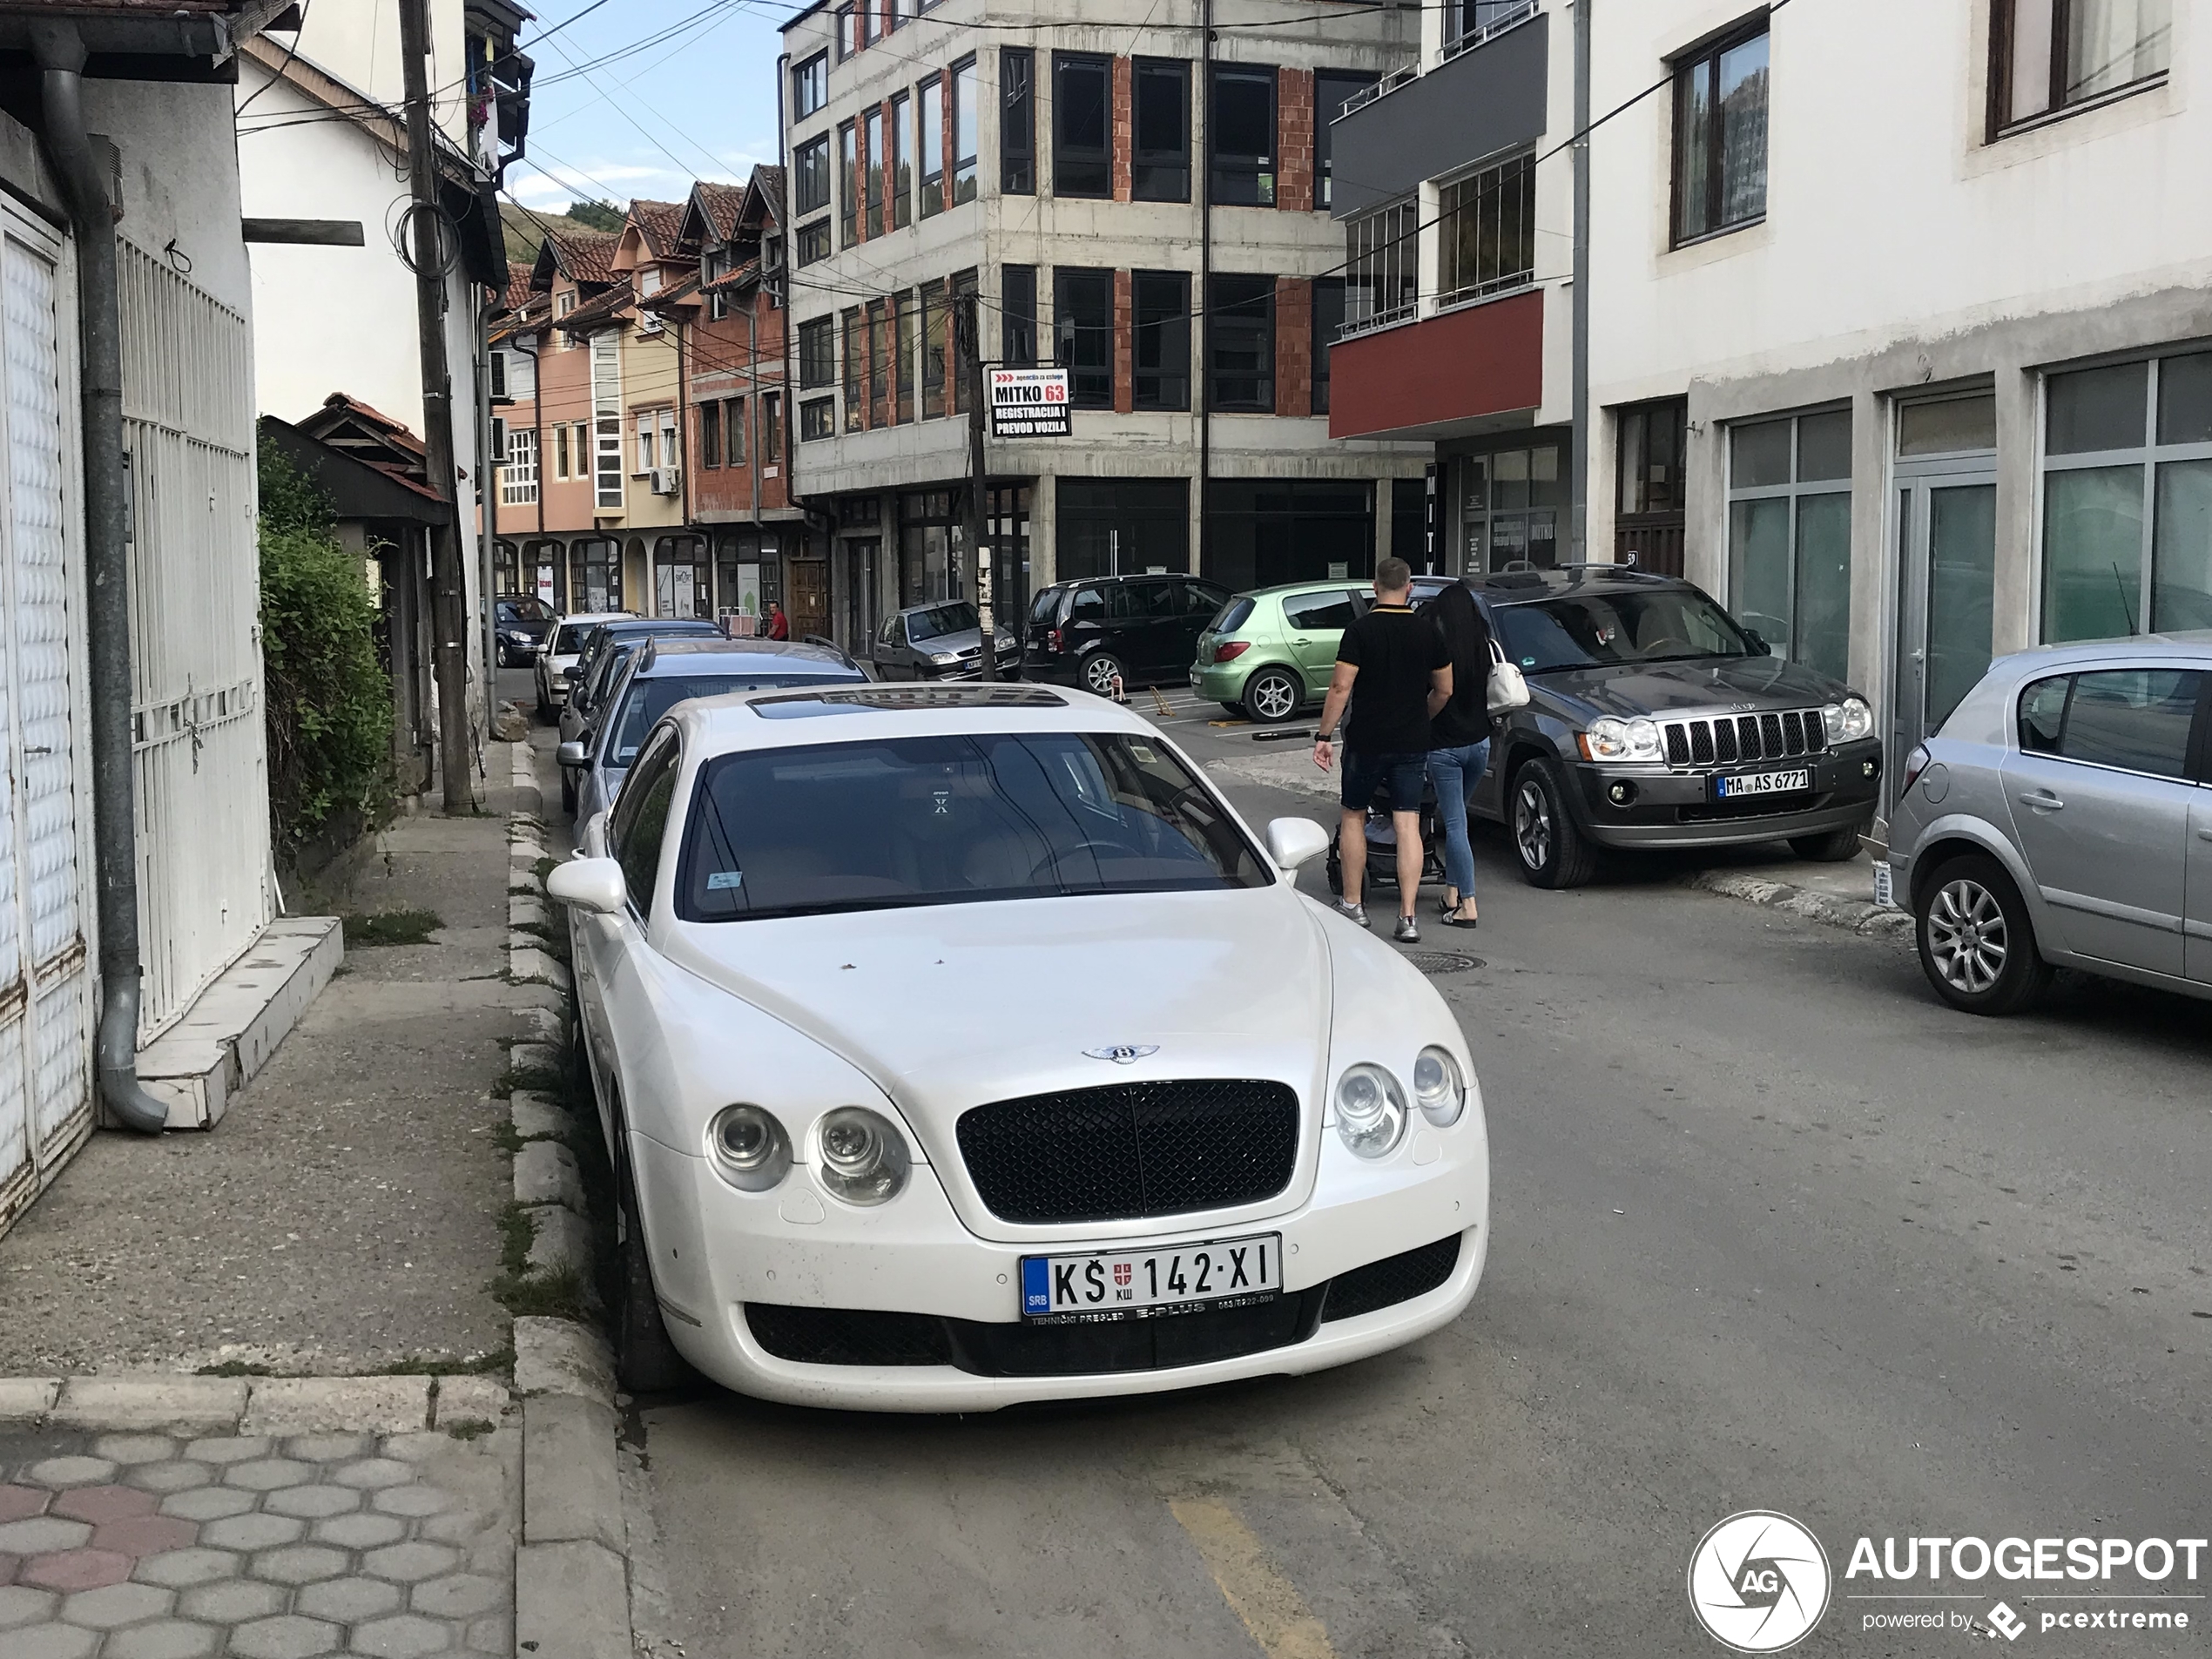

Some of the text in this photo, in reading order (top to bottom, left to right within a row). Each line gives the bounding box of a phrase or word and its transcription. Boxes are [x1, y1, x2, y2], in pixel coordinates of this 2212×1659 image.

[995, 385, 1064, 402] MITKO 63
[995, 406, 1066, 419] REGISTRACIJA I
[996, 421, 1067, 435] PREVOD VOZILA
[1726, 771, 1808, 794] MA AS 6771
[1055, 1260, 1105, 1305] KŠ
[1028, 1295, 1048, 1306] SRB
[1080, 1312, 1124, 1324] PREGLED
[1136, 1303, 1206, 1318] E-PLUS
